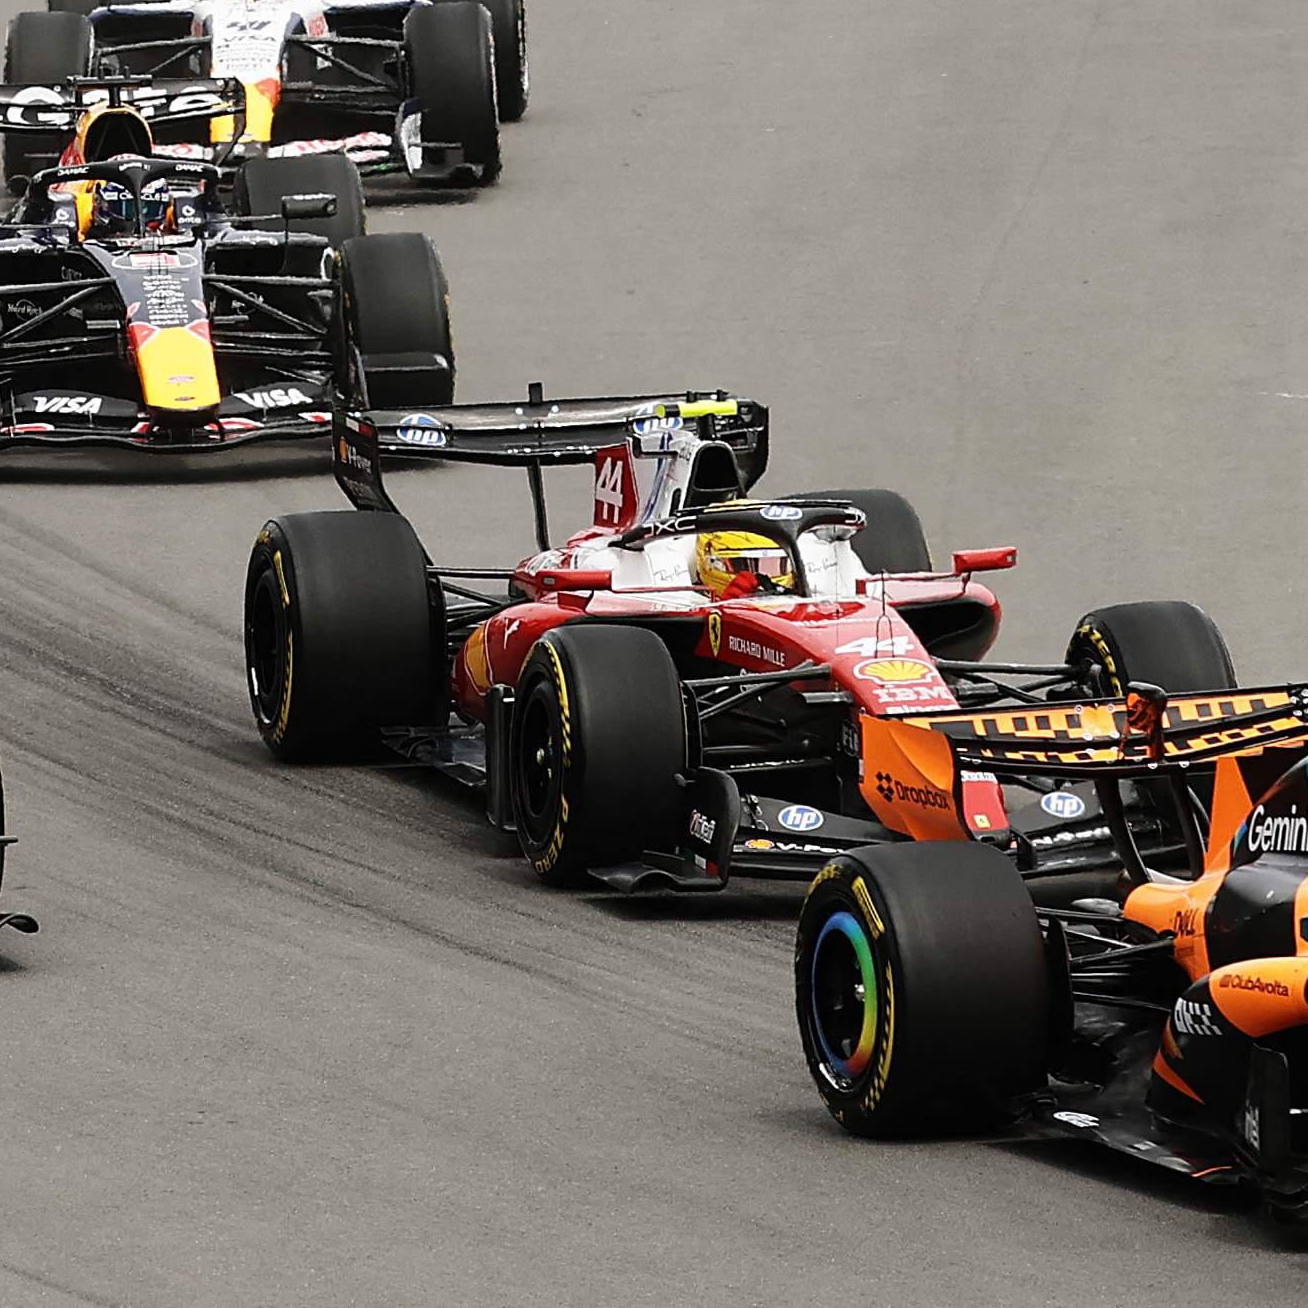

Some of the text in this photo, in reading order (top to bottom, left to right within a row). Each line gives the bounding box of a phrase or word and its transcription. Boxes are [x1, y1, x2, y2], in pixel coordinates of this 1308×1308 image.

[33, 397, 103, 414] VISA
[233, 388, 313, 409] VISA
[728, 635, 786, 667] RICHARD MILLE
[835, 635, 914, 657] 44
[871, 685, 952, 703] IBM
[894, 780, 950, 810] Dropbox
[1230, 974, 1290, 997] ClubAvolta
